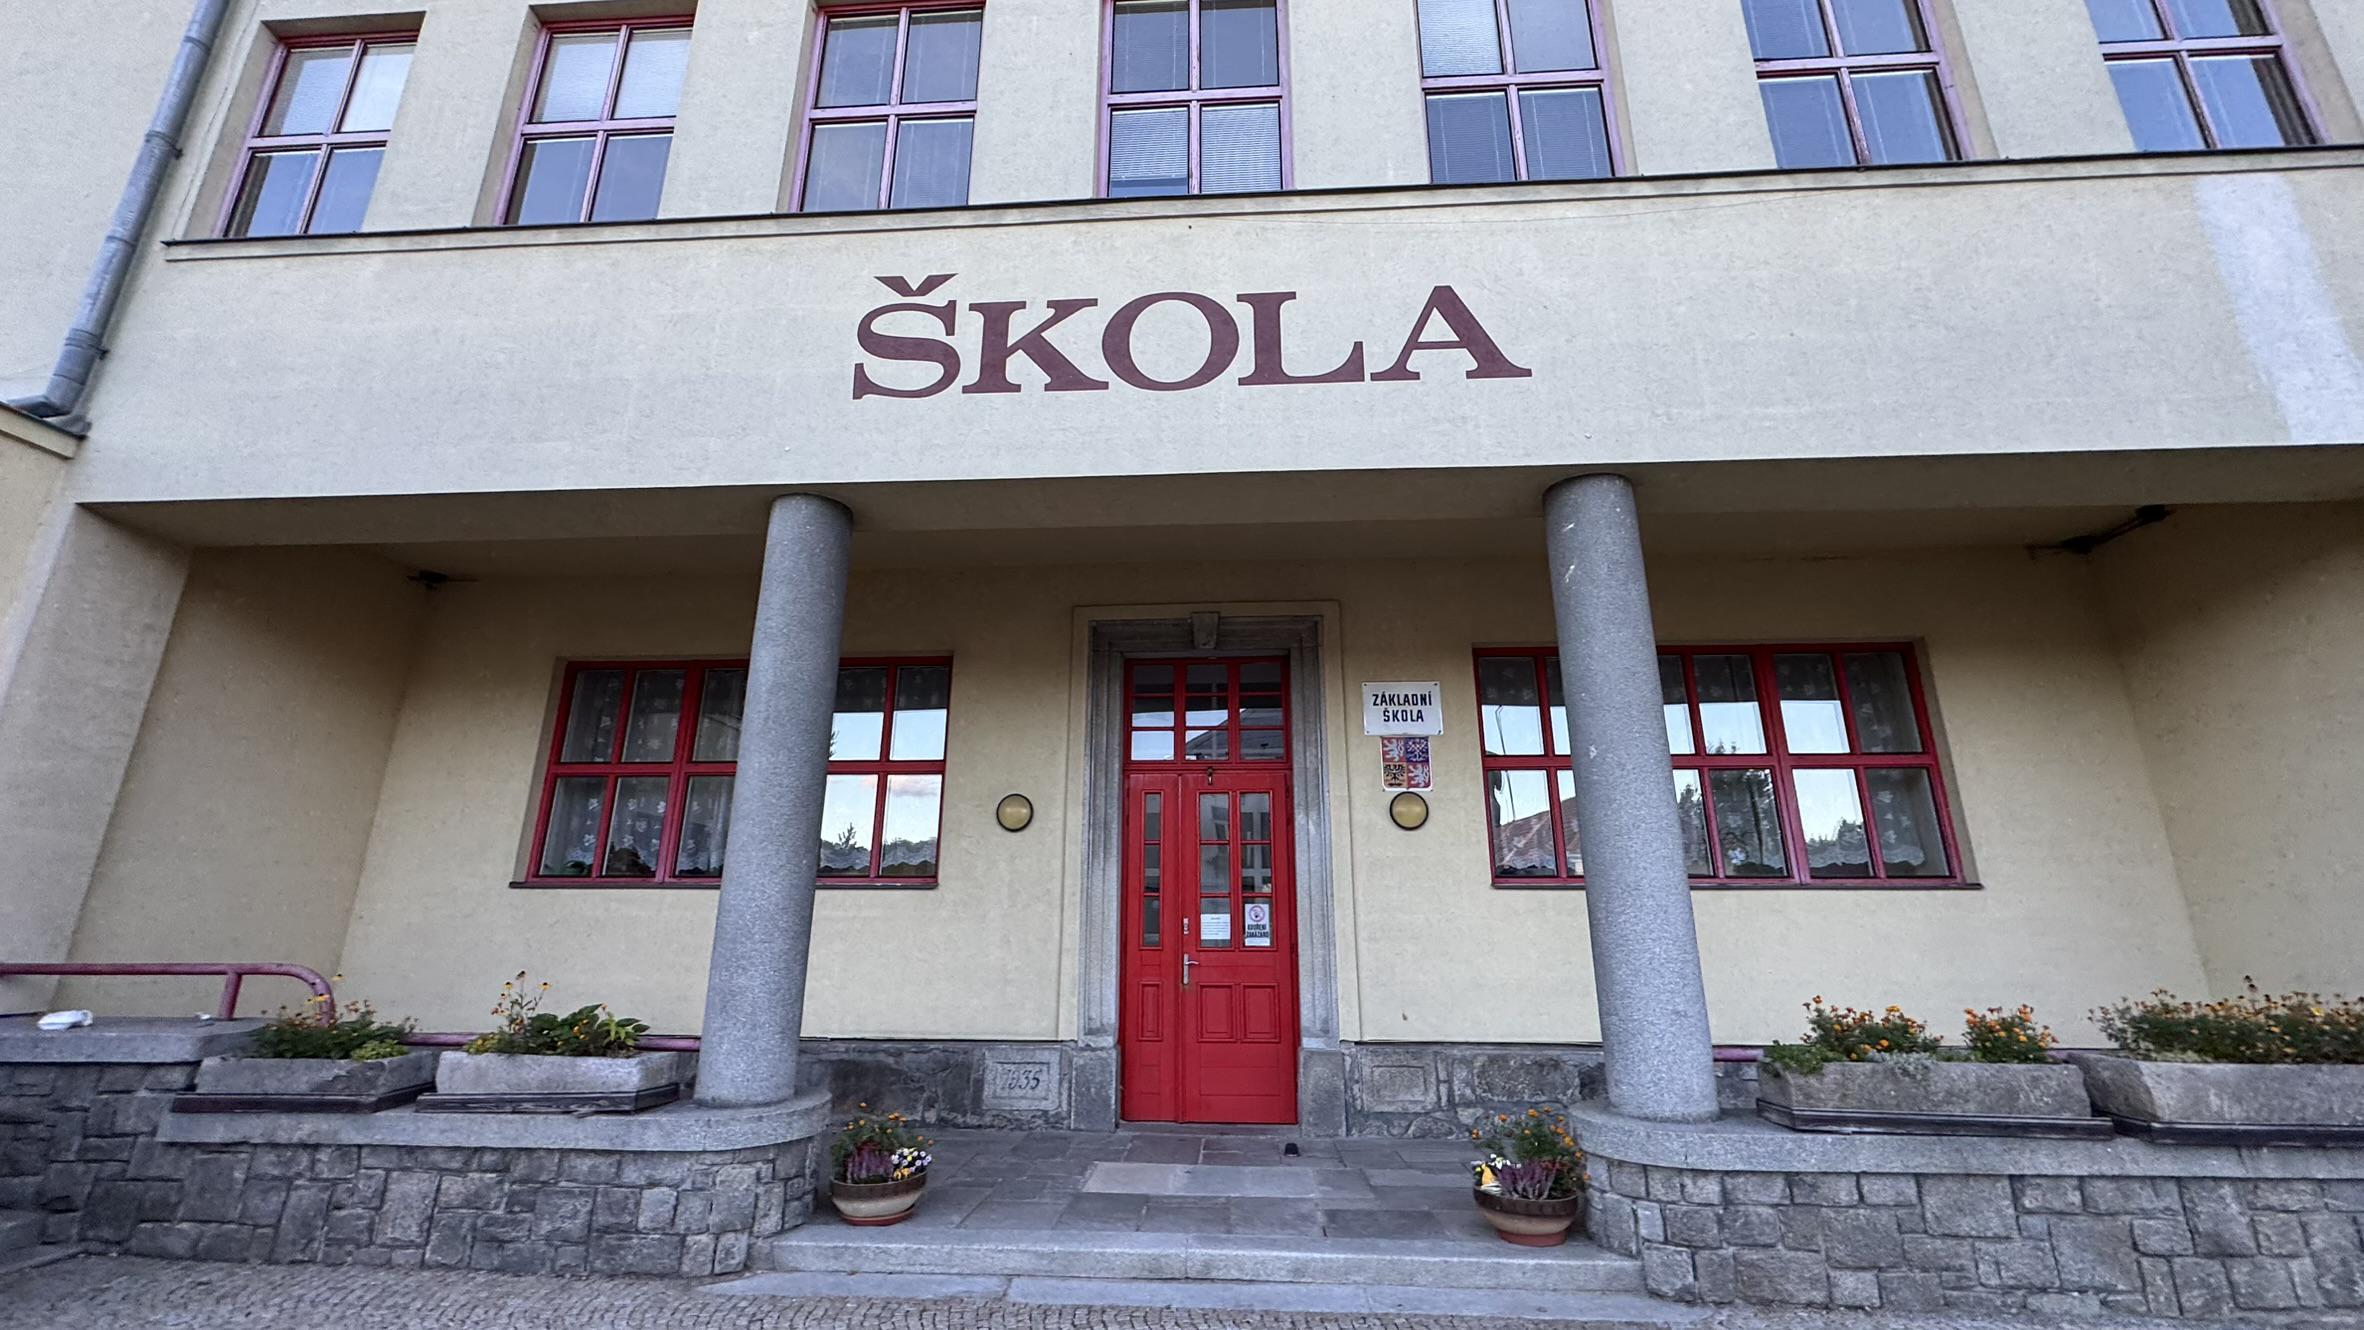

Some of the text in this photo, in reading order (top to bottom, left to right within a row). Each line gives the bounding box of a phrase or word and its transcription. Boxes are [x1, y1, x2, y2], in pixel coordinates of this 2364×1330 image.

[852, 273, 1532, 400] ŠKOLA
[1372, 691, 1432, 706] ZÁKLADNÍ
[1383, 708, 1424, 722] ŠKOLA
